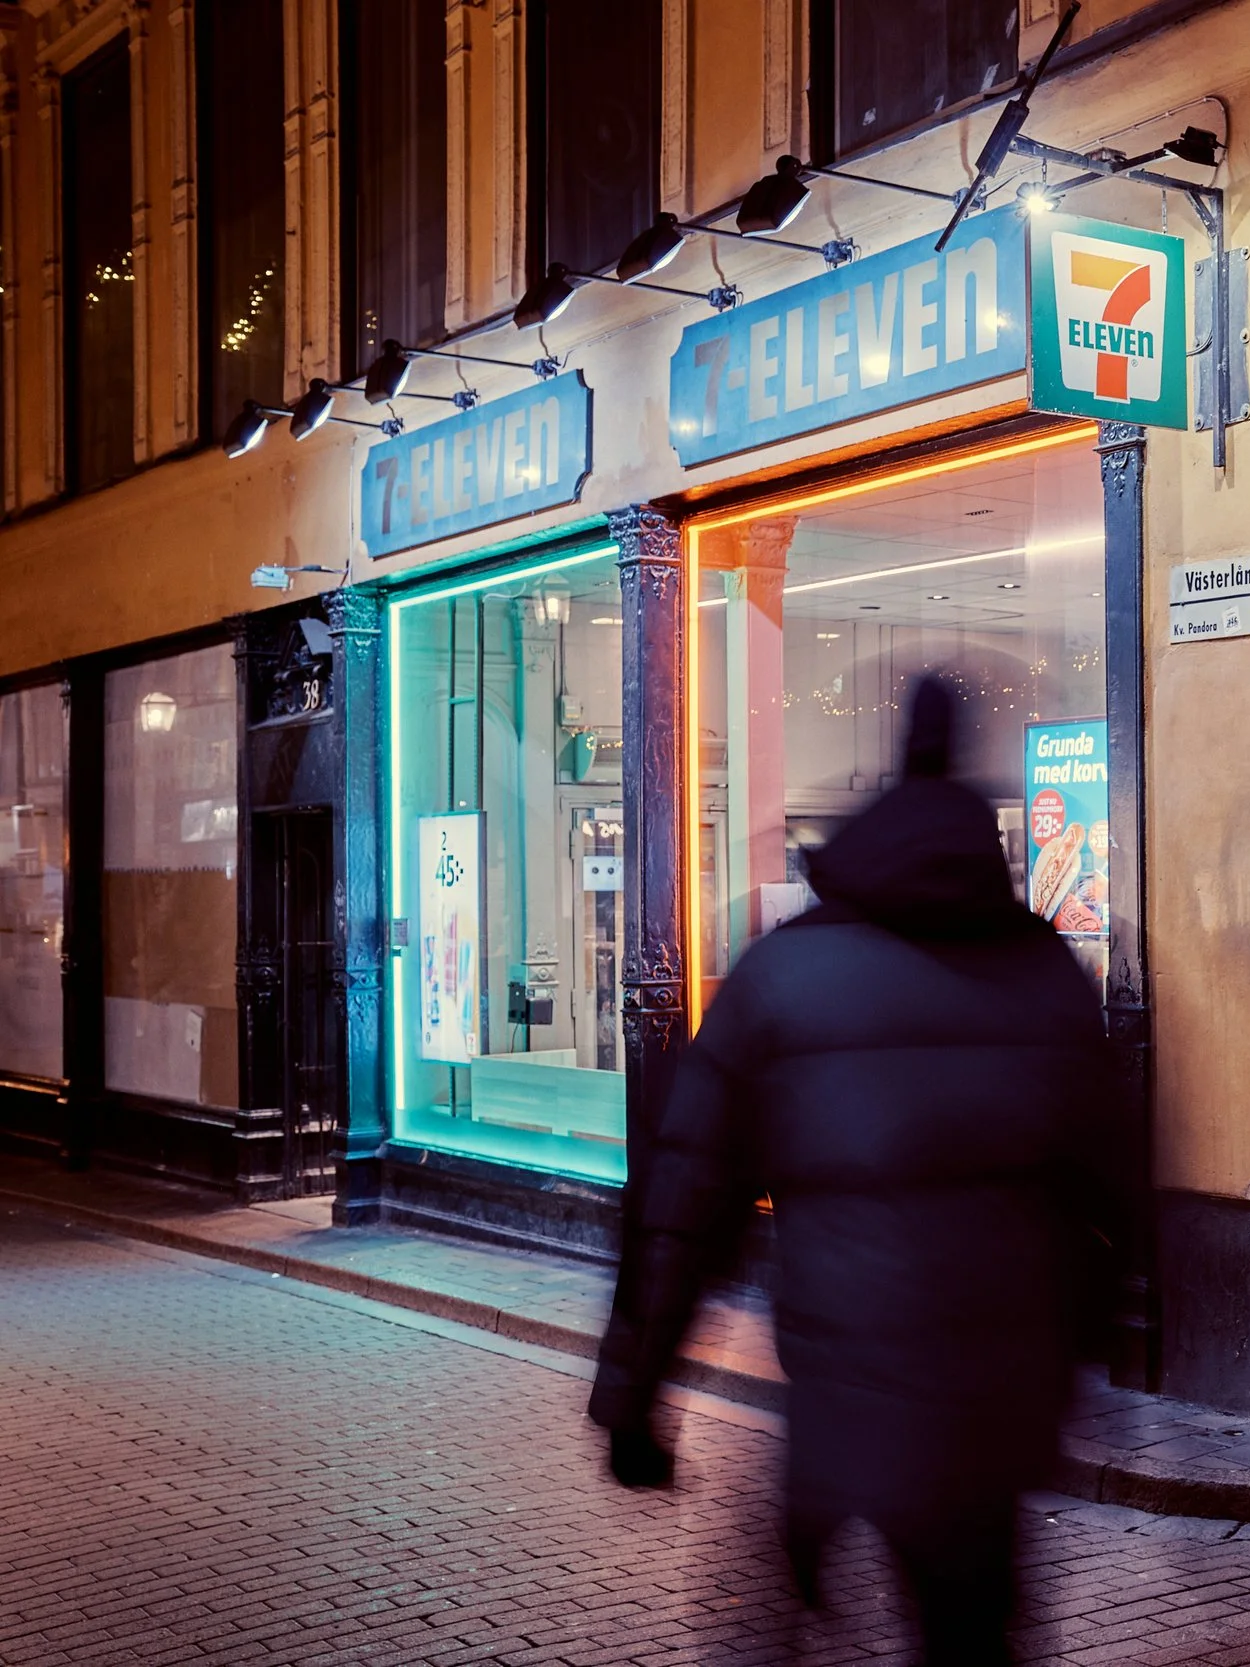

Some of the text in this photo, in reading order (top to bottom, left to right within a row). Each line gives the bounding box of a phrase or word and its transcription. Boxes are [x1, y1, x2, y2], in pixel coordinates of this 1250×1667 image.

[1071, 250, 1150, 400] 7
[1174, 621, 1218, 636] Kv. Pandora
[303, 679, 319, 710] 38
[1037, 731, 1094, 758] Grunda
[1034, 759, 1071, 784] med
[441, 831, 447, 851] 2
